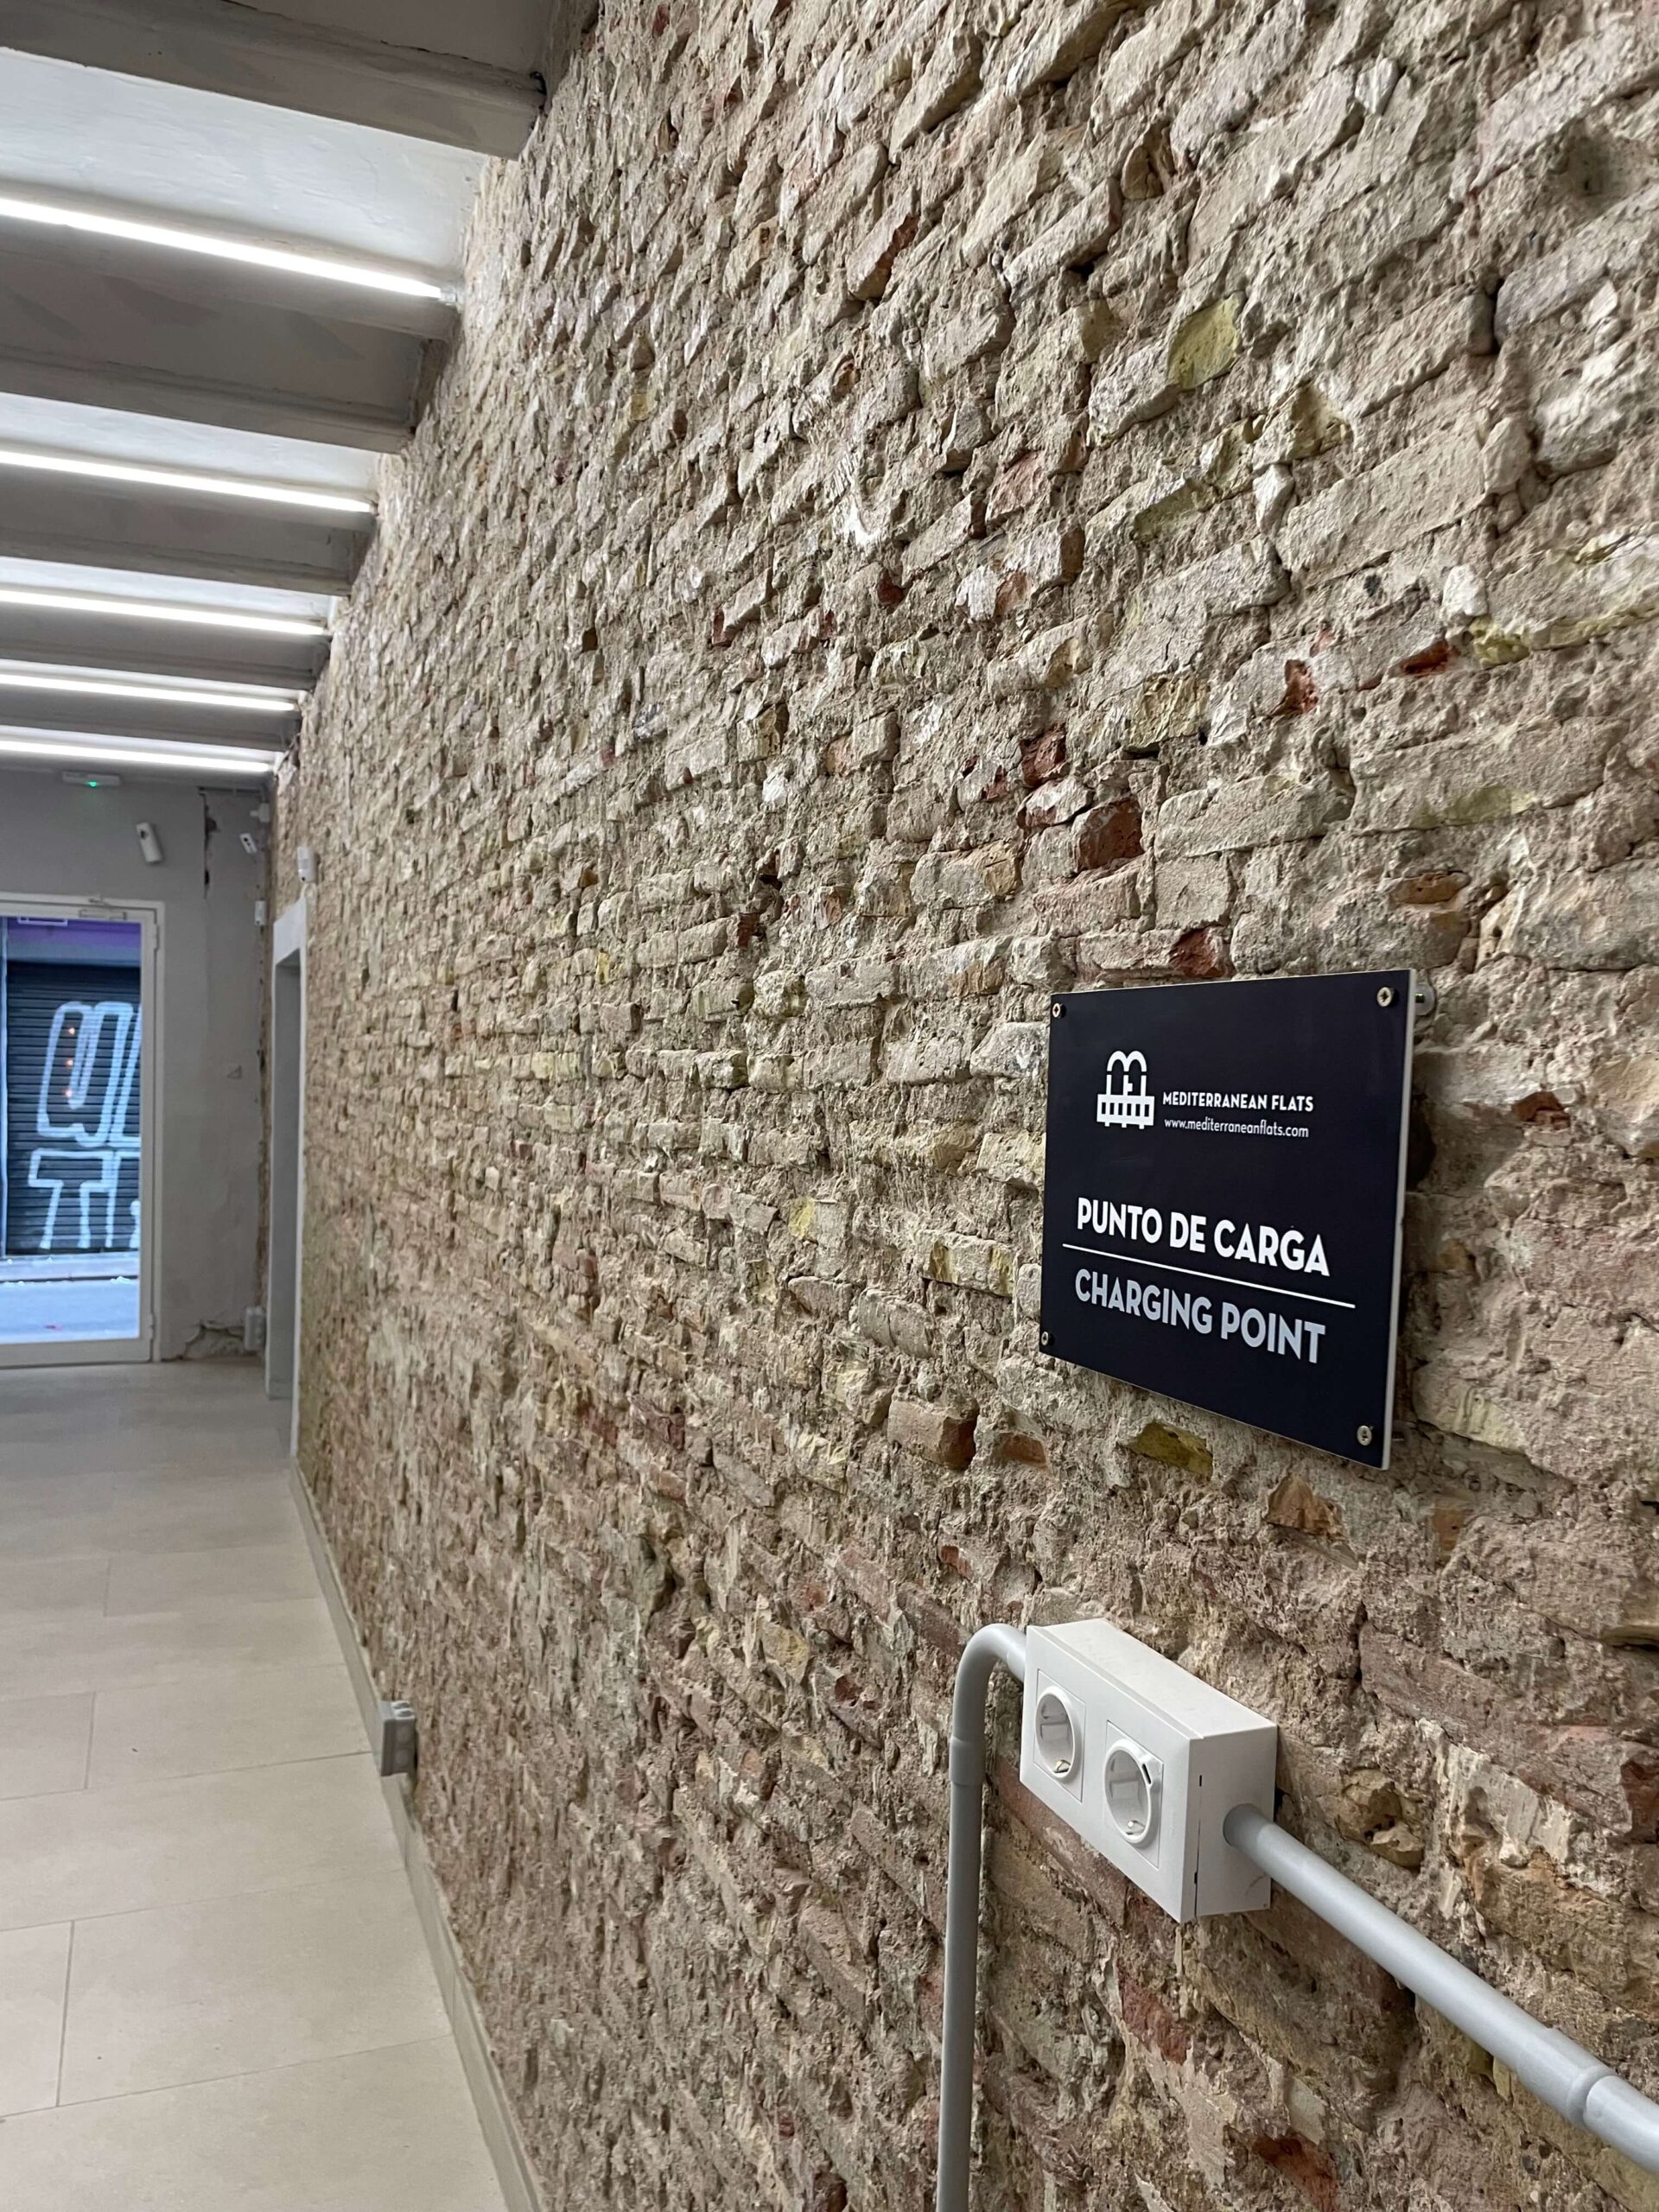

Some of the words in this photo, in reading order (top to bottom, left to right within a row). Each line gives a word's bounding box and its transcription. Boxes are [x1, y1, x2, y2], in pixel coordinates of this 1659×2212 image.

[1162, 1090, 1268, 1110] MEDITERRANEAN
[1271, 1094, 1314, 1112] FLATS
[1164, 1116, 1309, 1138] www.mediterraneanflats.com
[1077, 1197, 1163, 1244] PUNTO
[1169, 1211, 1207, 1254] DE
[1213, 1219, 1331, 1277] CARGA
[1075, 1268, 1213, 1334] CHARGING
[1220, 1301, 1326, 1363] POINT
